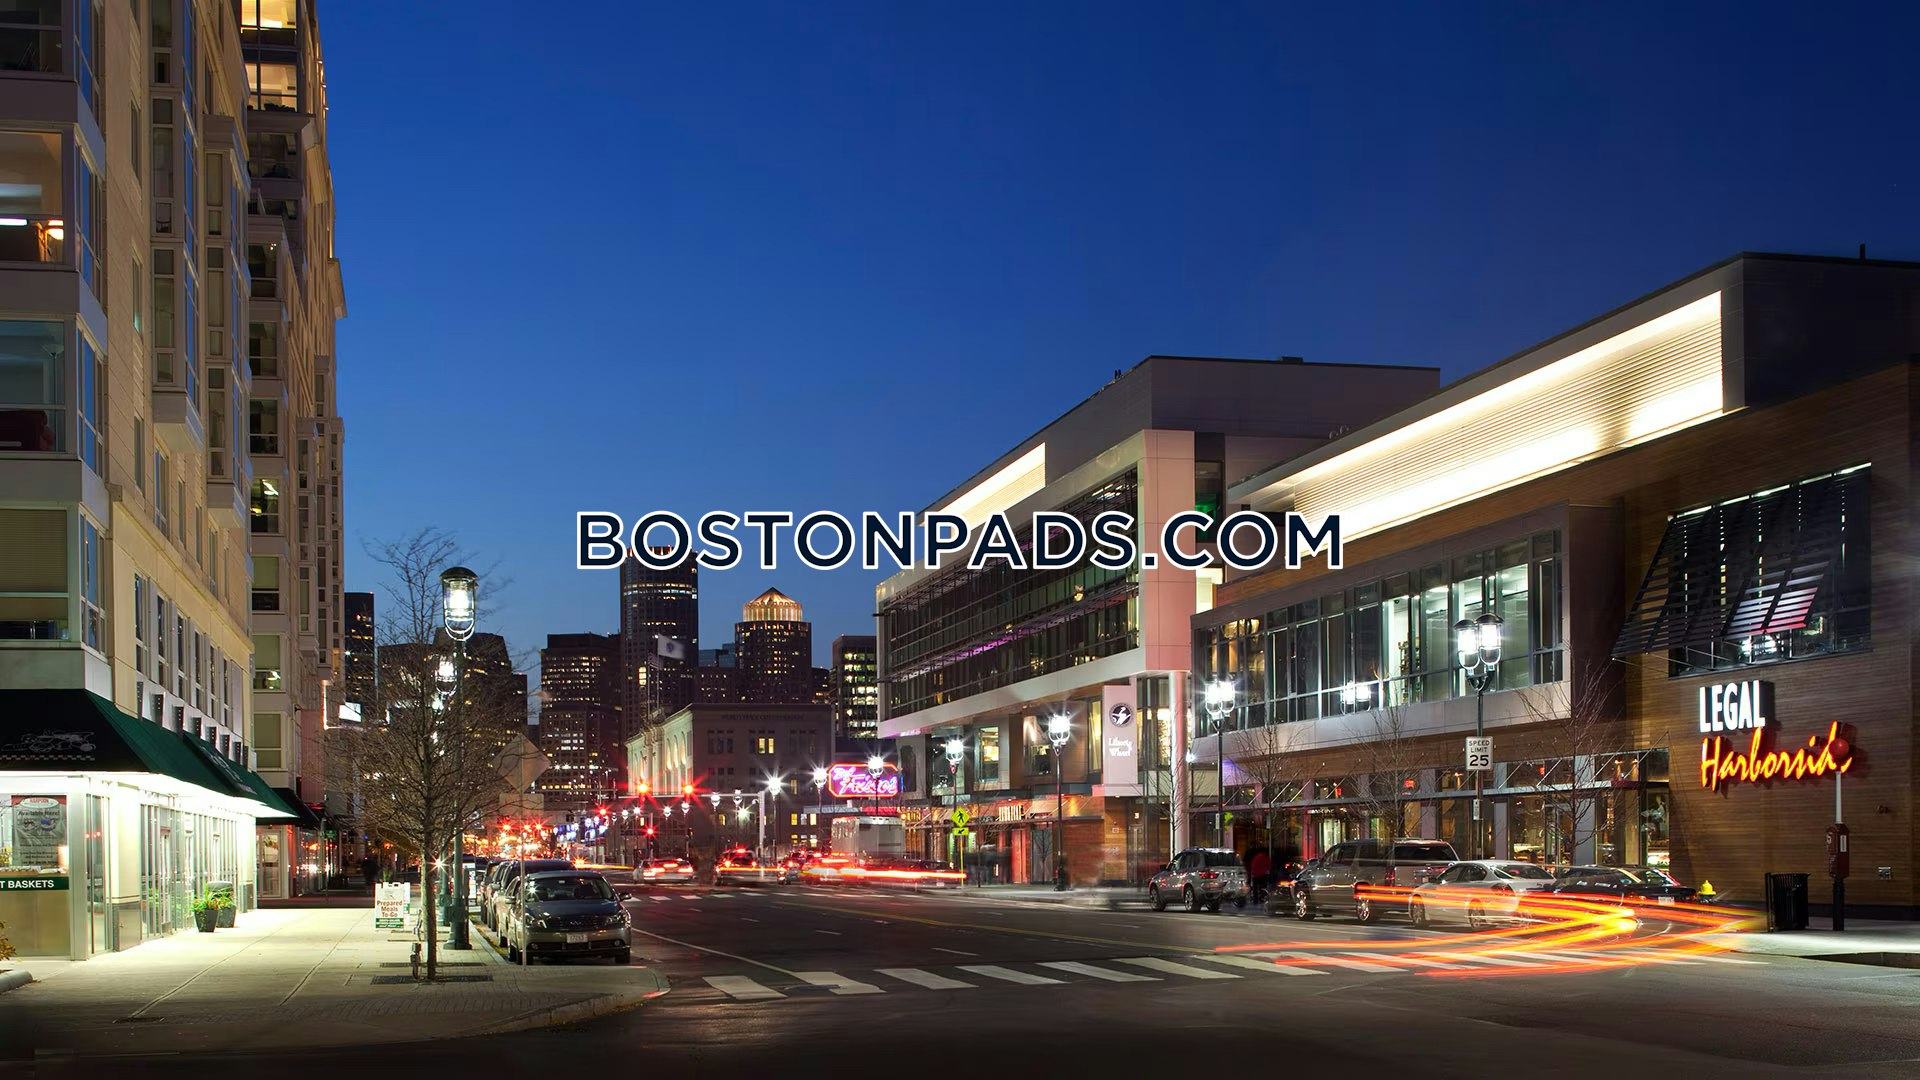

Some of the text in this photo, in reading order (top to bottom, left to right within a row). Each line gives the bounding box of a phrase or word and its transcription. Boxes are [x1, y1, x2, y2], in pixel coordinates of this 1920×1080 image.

[1700, 680, 1765, 732] LEGAL
[1109, 747, 1130, 757] Wharf
[1701, 720, 1852, 791] Harborsid
[1469, 754, 1489, 767] 25
[8, 880, 54, 889] BASKETS
